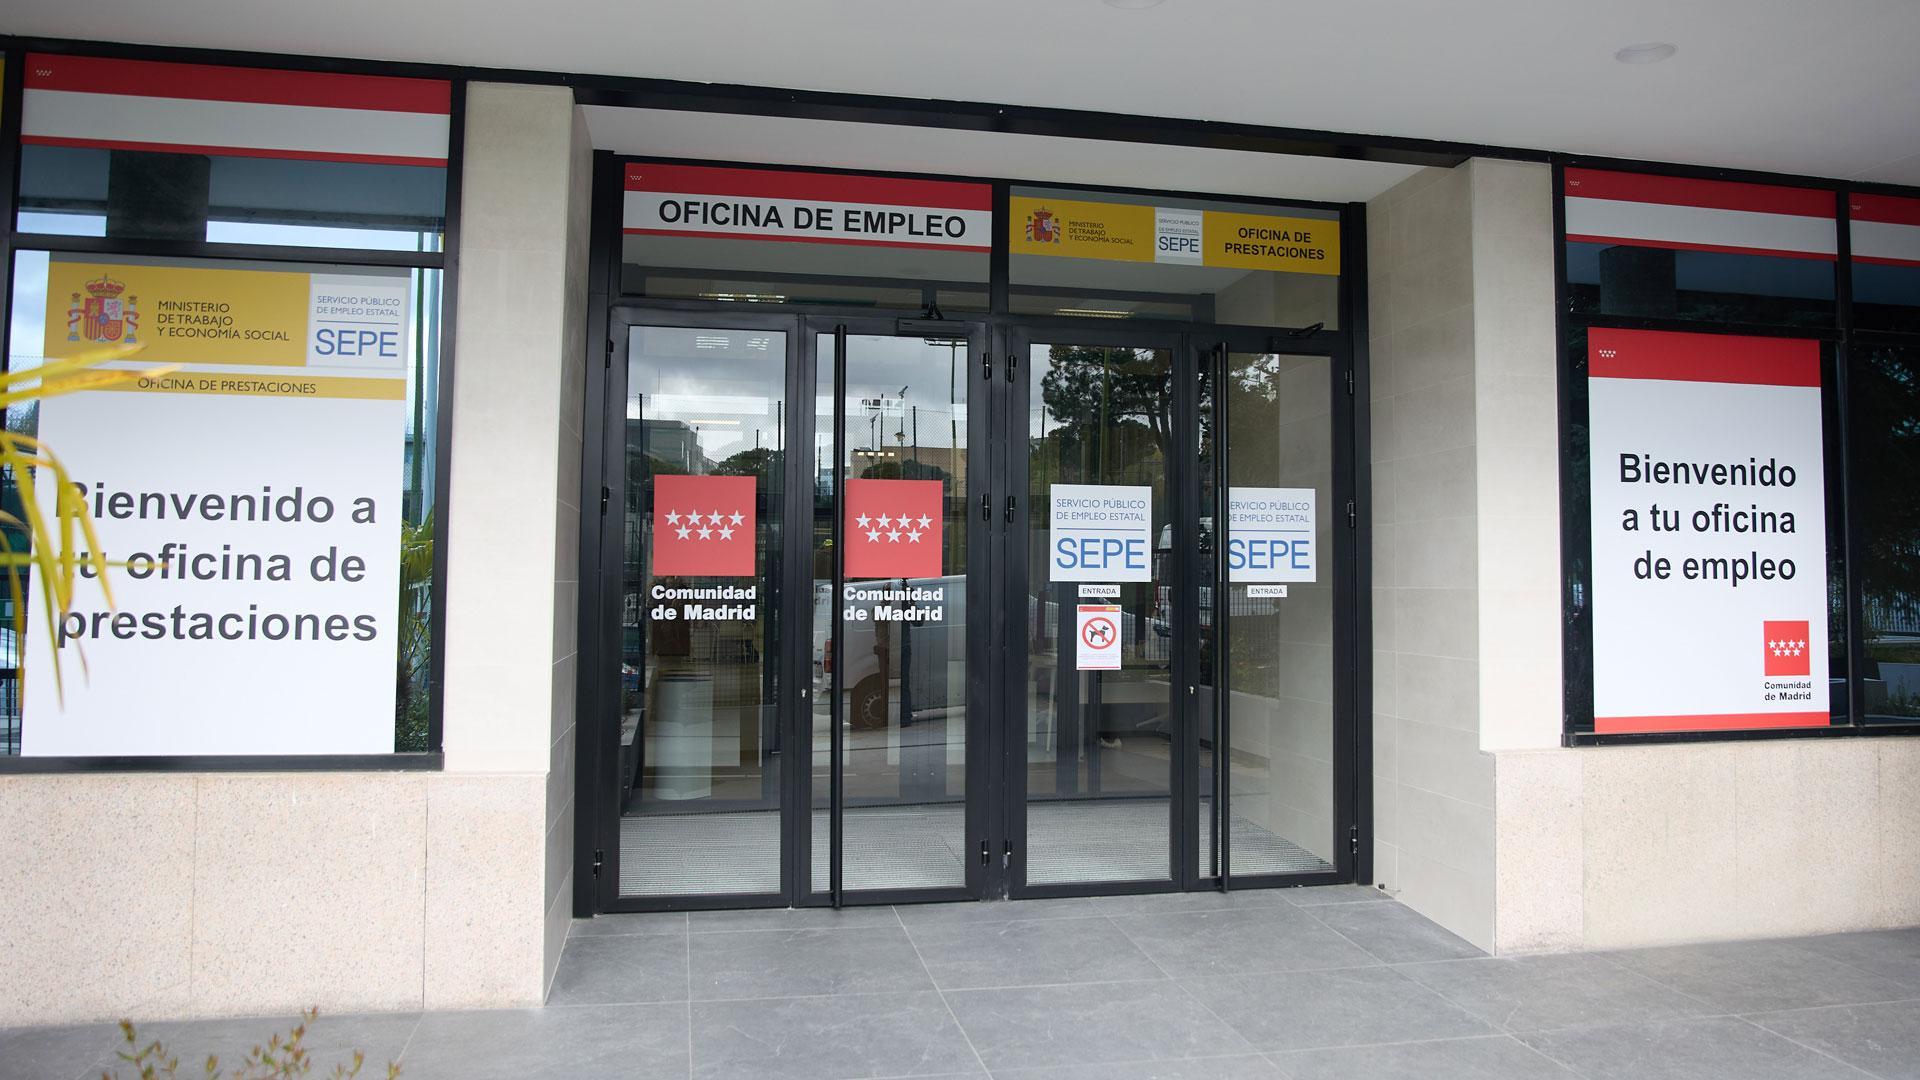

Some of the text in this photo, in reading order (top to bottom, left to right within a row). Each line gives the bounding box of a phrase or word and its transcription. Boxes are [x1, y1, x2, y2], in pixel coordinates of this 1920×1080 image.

[659, 200, 966, 238] OFICINA DE EMPLEO
[1069, 221, 1104, 229] MINISTERIO
[1075, 235, 1110, 243] ECONOMÍA
[1078, 228, 1106, 236] TRABAJO
[1238, 227, 1311, 243] OFICINA DE
[1158, 236, 1200, 253] SEPE
[1225, 243, 1325, 260] PRESTACIONES
[158, 300, 230, 313] MINISTERIO
[317, 295, 400, 306] SERVICIO PÚBLICO
[316, 306, 400, 317] DE EMPLEO ESTATAL
[157, 313, 233, 328] DE TRABAJO
[157, 326, 290, 342] Y ECONOMÍA SOCIAL
[315, 328, 398, 357] SEPE
[138, 377, 316, 394] OFICINA DE PRESTACIONES
[1620, 453, 1796, 487] Bienvenido
[351, 497, 376, 523] a
[1056, 498, 1146, 509] SERVICIO PÚBLICO
[1229, 500, 1310, 511] ERVICIO PÚBLICO
[1056, 511, 1145, 521] DE EMPLEO ESTATAL
[1239, 513, 1273, 522] EMPLEO
[1275, 514, 1310, 523] ESTATAL
[1622, 503, 1796, 533] a tu oficina
[1056, 537, 1145, 569] SEPE
[1229, 538, 1310, 570] SEPE
[126, 543, 291, 581] oficina
[310, 546, 366, 582] de
[1634, 550, 1796, 587] de empleo
[651, 585, 756, 600] Comunidad
[843, 586, 943, 601] Comunidad
[1082, 587, 1116, 595] ENTRADA
[651, 604, 756, 621] de Madrid
[843, 605, 943, 621] de Madrid
[57, 604, 377, 648] prestaciones
[1764, 681, 1811, 690] Comunidad
[1764, 692, 1811, 701] de Madrid
